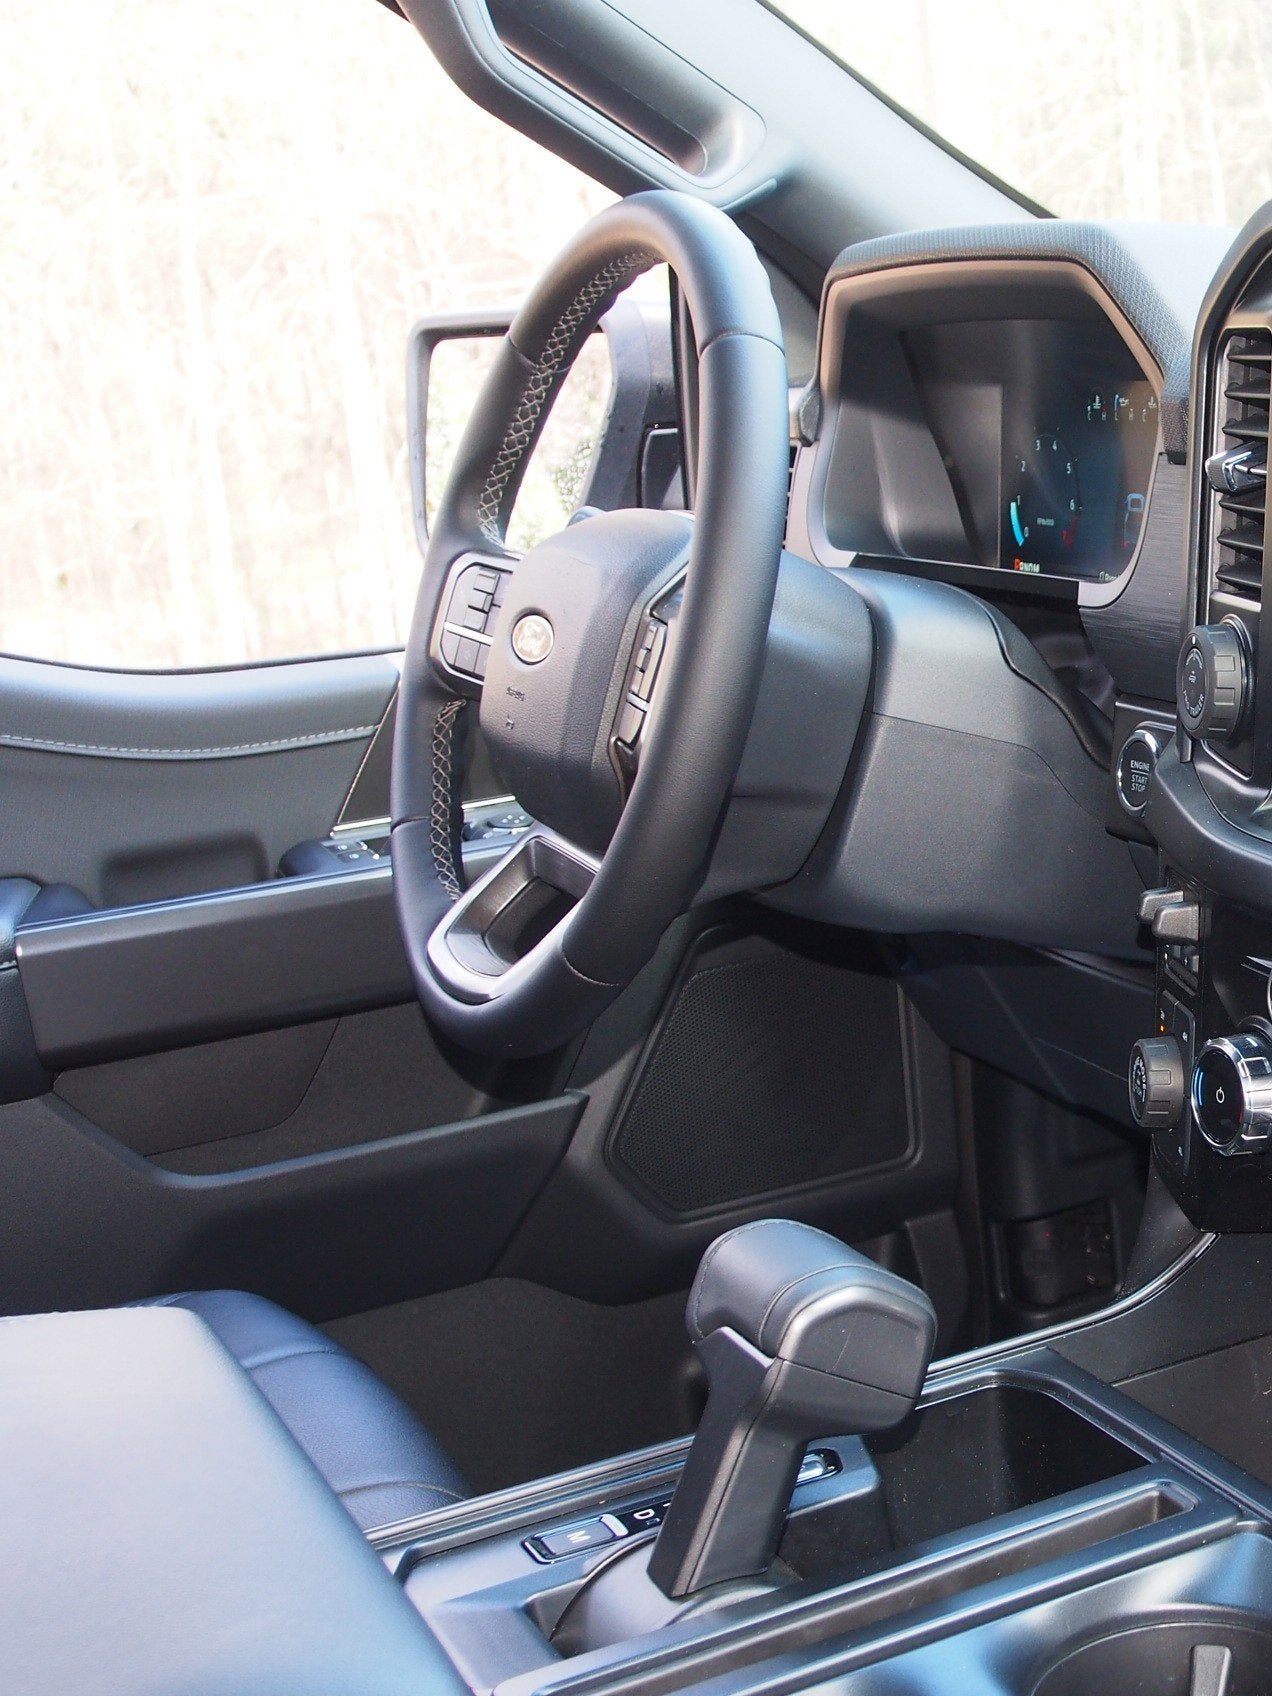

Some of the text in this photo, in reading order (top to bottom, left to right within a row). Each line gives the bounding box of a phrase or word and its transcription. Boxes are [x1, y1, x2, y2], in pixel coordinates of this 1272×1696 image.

[1131, 760, 1150, 770] ENGINE
[1130, 775, 1148, 784] START
[1131, 783, 1146, 792] STOP
